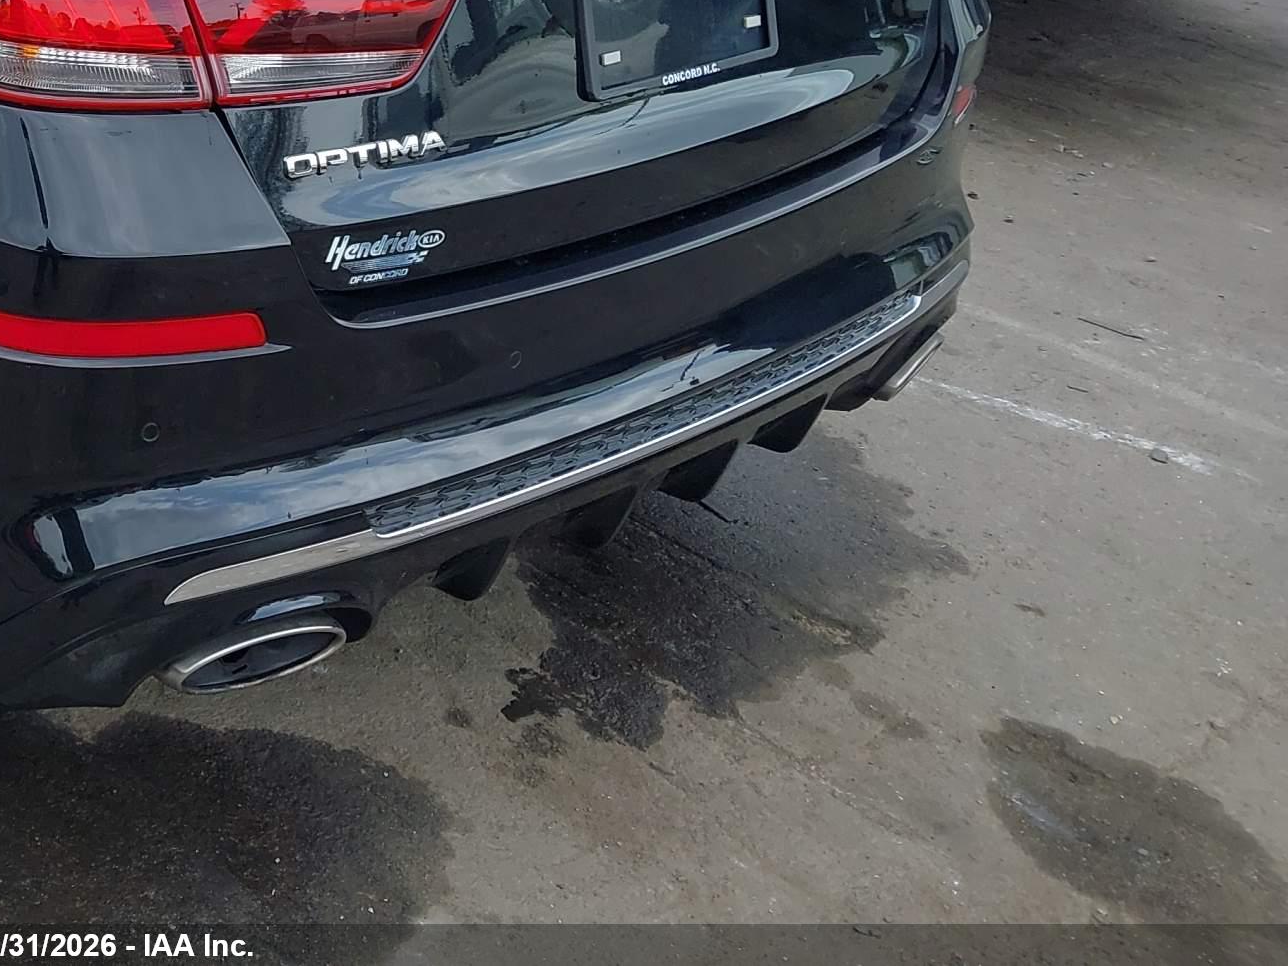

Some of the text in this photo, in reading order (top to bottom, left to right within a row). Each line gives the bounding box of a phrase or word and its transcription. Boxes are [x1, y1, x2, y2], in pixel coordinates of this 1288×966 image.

[662, 62, 721, 86] CONCORD N.C.
[283, 130, 448, 179] OPTIMA
[325, 230, 419, 271] Hendrick
[349, 268, 409, 285] OF CONCORD
